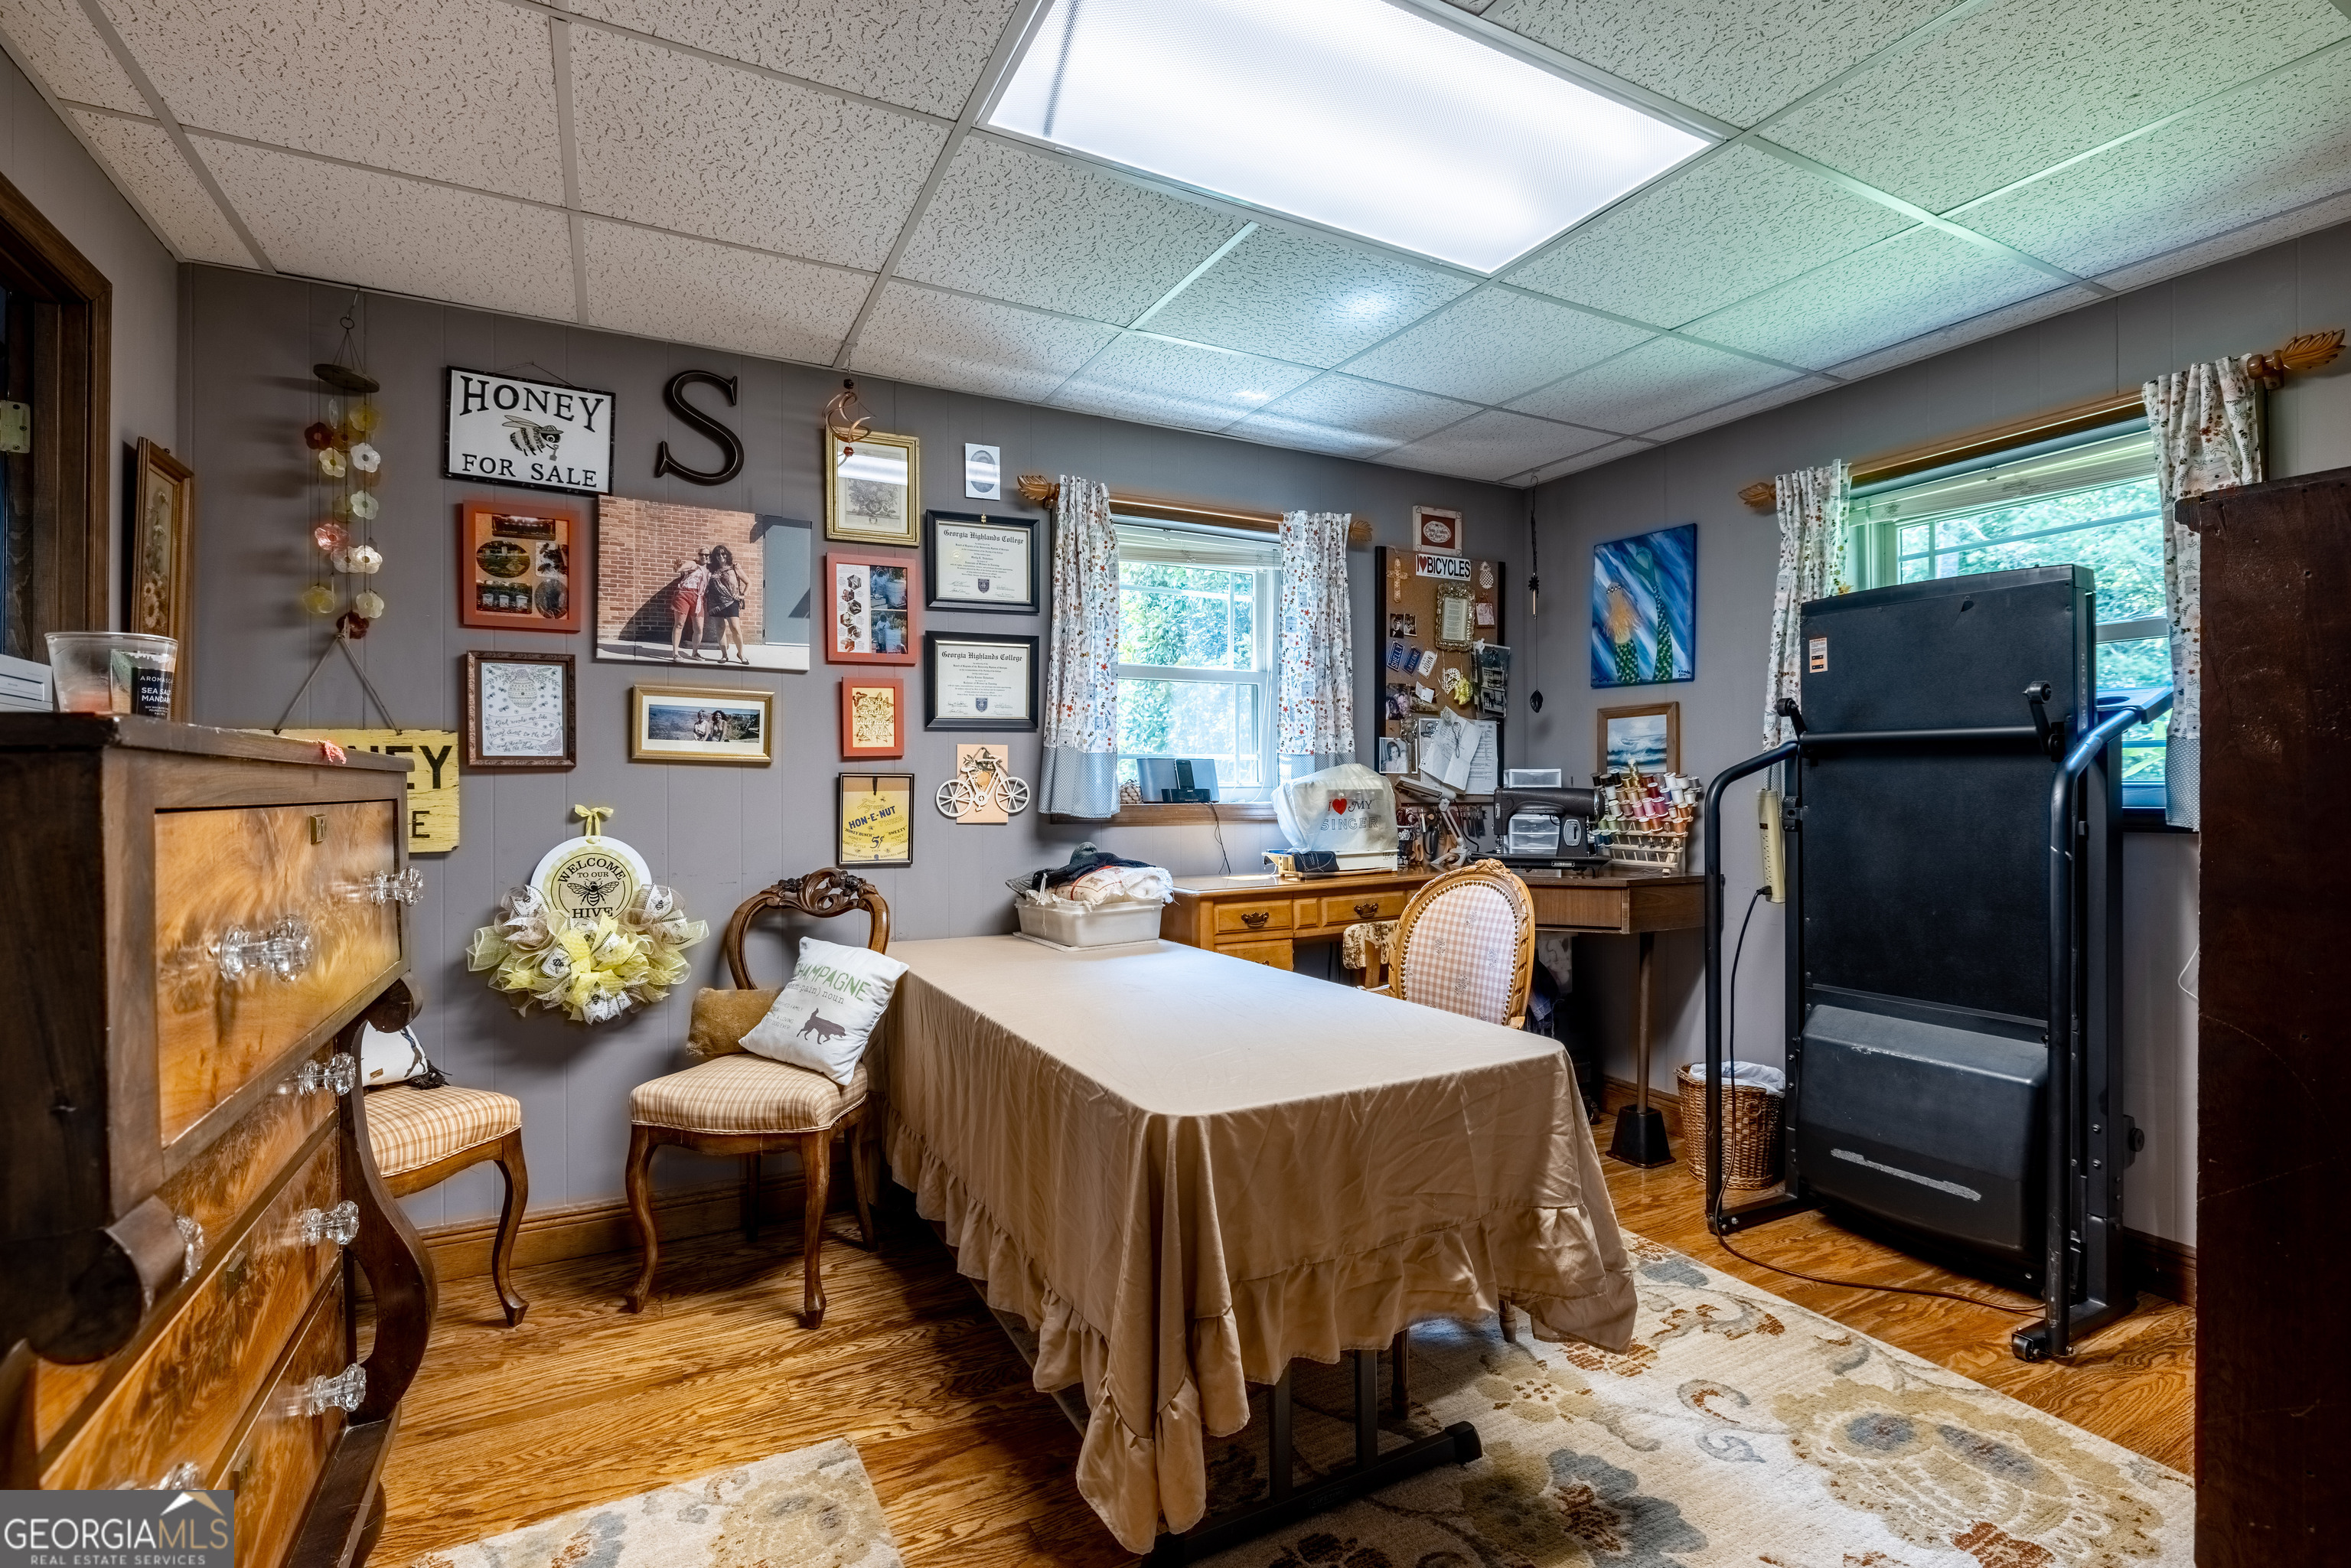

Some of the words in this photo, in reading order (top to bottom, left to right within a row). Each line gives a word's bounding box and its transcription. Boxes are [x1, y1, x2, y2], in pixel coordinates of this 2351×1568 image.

[459, 375, 605, 433] HONEY
[656, 370, 744, 486] S
[461, 453, 517, 478] FOR
[531, 463, 597, 488] SALE
[944, 529, 968, 539] Georgia
[970, 531, 1000, 541] Highlands
[1002, 536, 1024, 545] College
[1417, 555, 1420, 572] I
[1427, 556, 1471, 578] BICYCLES
[941, 650, 966, 660] Georgia
[968, 651, 999, 660] Highlands
[1000, 654, 1022, 663] College
[1391, 644, 1403, 668] SHELLY
[1423, 654, 1434, 673] JOHN
[857, 798, 876, 813] Try
[1348, 800, 1372, 812] MY
[849, 806, 895, 829] HON-E-NUT
[879, 815, 904, 826] TWINS
[1321, 817, 1378, 830] SINGER
[558, 857, 626, 882] WELCOME
[572, 908, 613, 918] HIVE
[796, 963, 871, 1001] CHAMPAGNE
[822, 990, 845, 1005] noun
